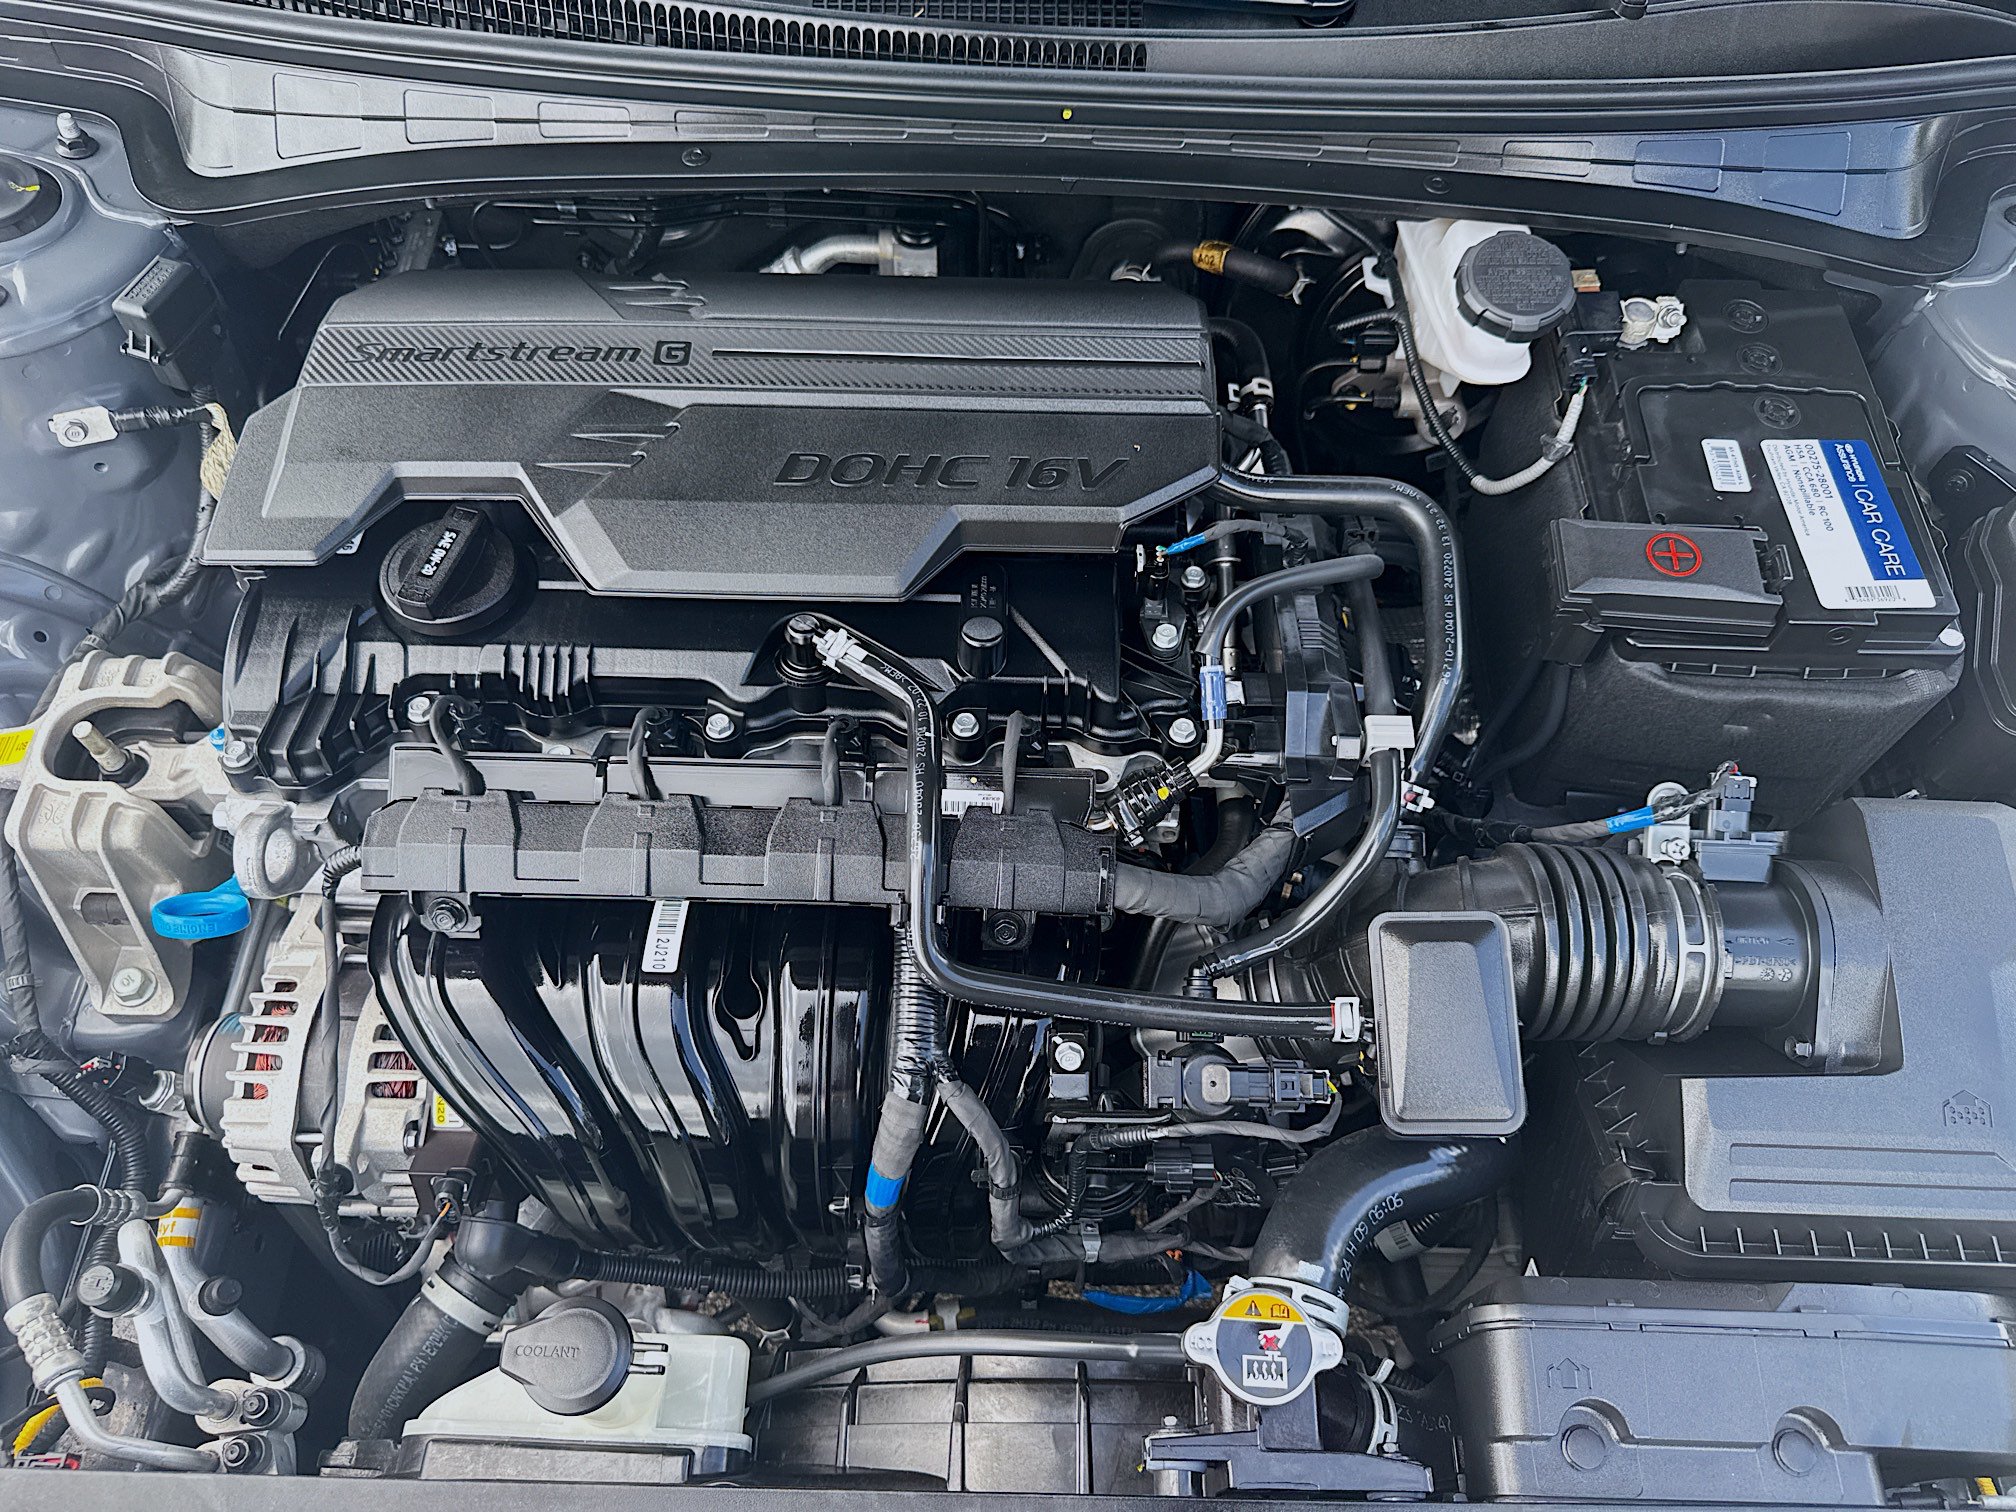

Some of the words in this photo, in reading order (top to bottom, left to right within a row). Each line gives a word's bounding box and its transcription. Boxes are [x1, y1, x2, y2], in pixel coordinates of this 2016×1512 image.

[346, 341, 642, 364] Smartstream
[773, 452, 990, 489] DOHC
[1004, 455, 1130, 491] 16V
[1804, 444, 1833, 498] 00275-28001
[1834, 443, 1856, 481] Assurance
[1783, 444, 1795, 461] AGM
[1792, 469, 1816, 515] Nonspillable
[1802, 466, 1814, 481] CCA
[1809, 483, 1820, 497] 680
[1817, 505, 1828, 516] RC
[1822, 518, 1834, 531] 100
[1853, 489, 1884, 523] CAR
[1869, 528, 1906, 576] CARE
[438, 530, 457, 549] SAE
[420, 548, 447, 576] 0W-20
[1443, 552, 1454, 589] 240720
[1444, 594, 1454, 607] HS
[915, 762, 925, 775] HS
[652, 938, 670, 970] 2J210
[1354, 1221, 1368, 1242] 09
[1346, 1241, 1358, 1256] H
[1340, 1258, 1353, 1282] 24
[515, 1345, 579, 1358] COOLANT
